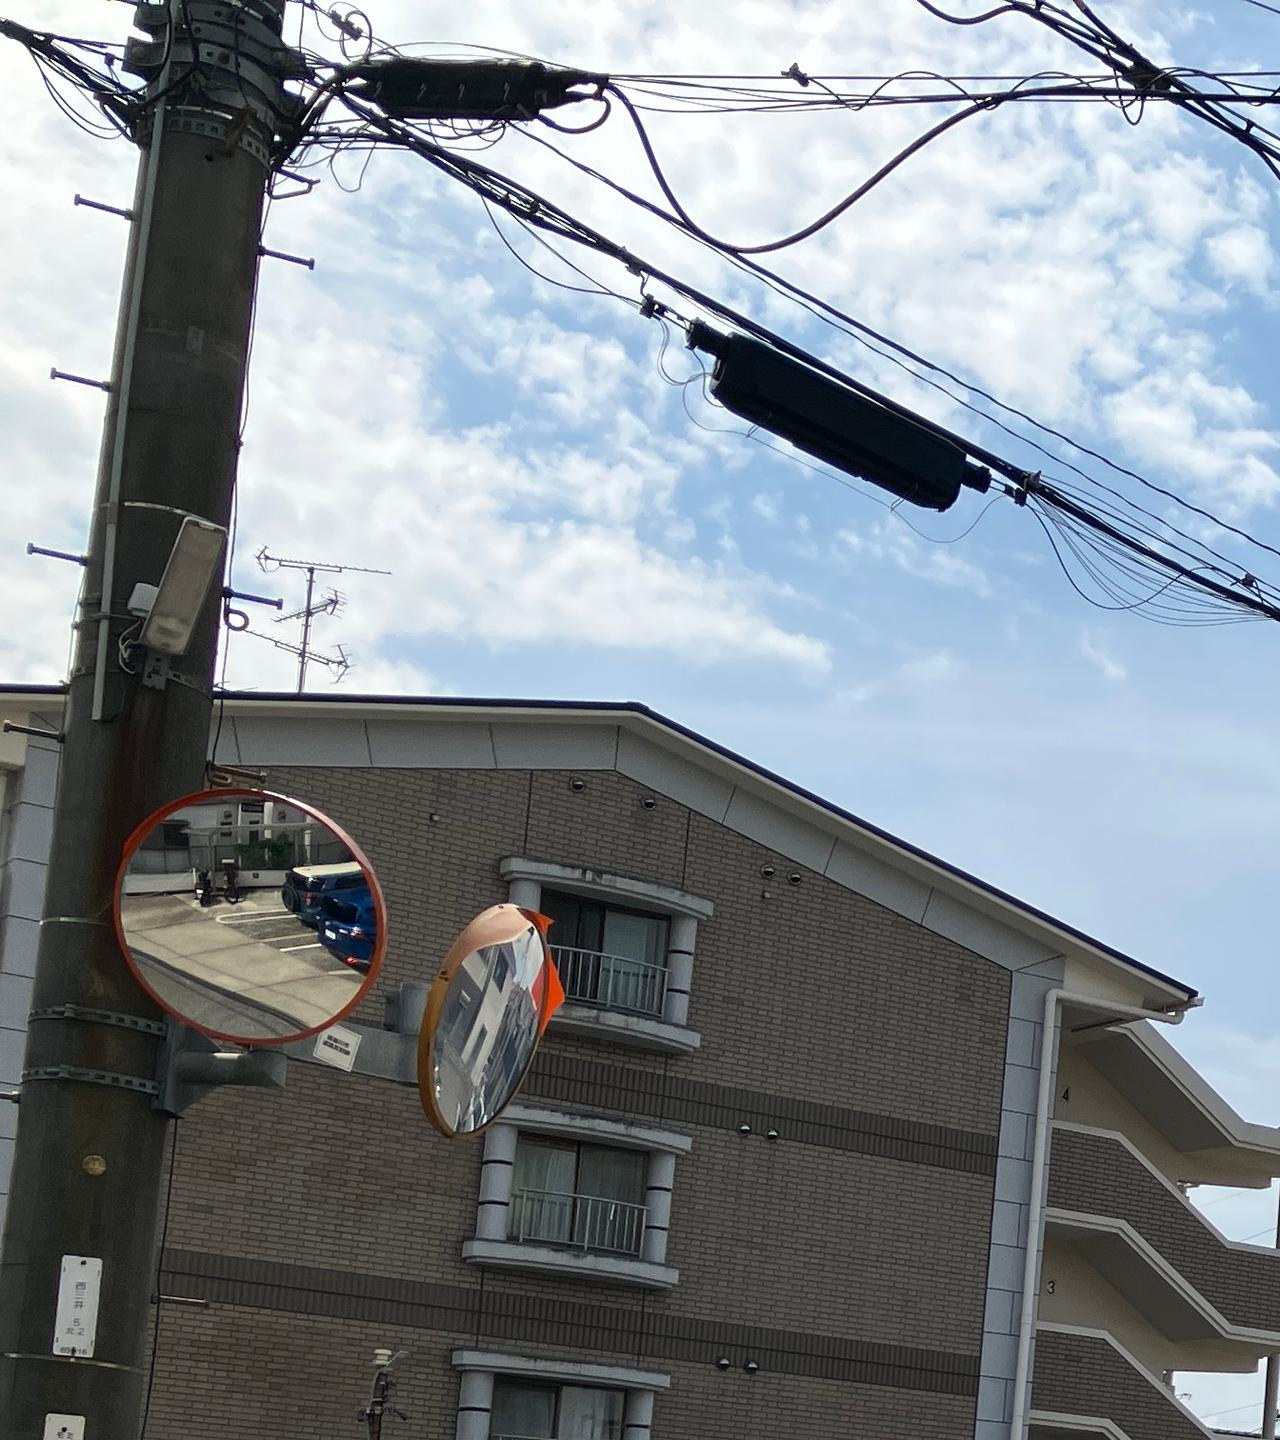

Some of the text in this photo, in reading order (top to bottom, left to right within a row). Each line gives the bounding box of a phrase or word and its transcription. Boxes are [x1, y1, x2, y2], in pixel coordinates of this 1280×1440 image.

[1062, 1087, 1069, 1101] 4
[1047, 1280, 1055, 1294] 3
[73, 1318, 81, 1327] 5
